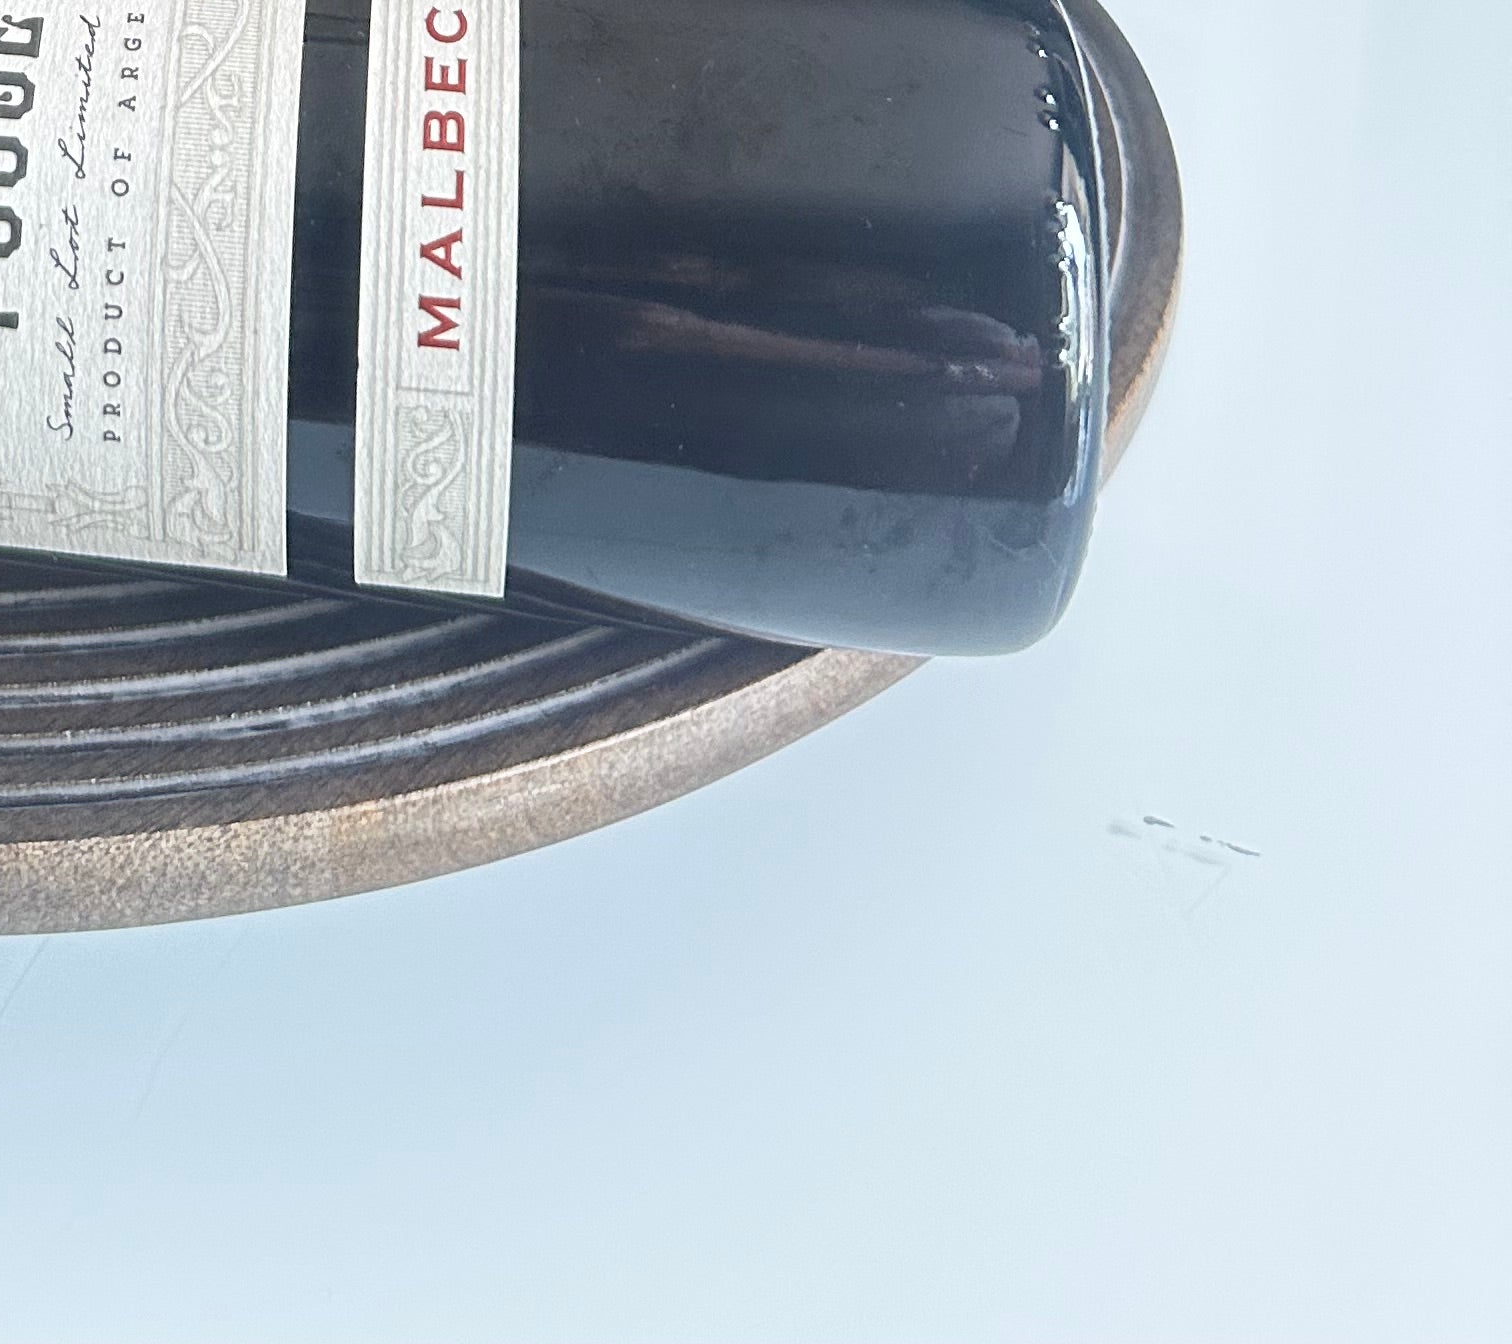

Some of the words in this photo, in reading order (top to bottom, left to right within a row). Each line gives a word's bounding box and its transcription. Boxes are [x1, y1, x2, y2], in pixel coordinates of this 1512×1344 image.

[57, 14, 101, 180] Limited
[110, 147, 132, 198] OF
[418, 8, 468, 350] MALBEC
[49, 204, 80, 291] Lot
[46, 316, 77, 442] Small
[102, 237, 126, 443] PRODUCT
